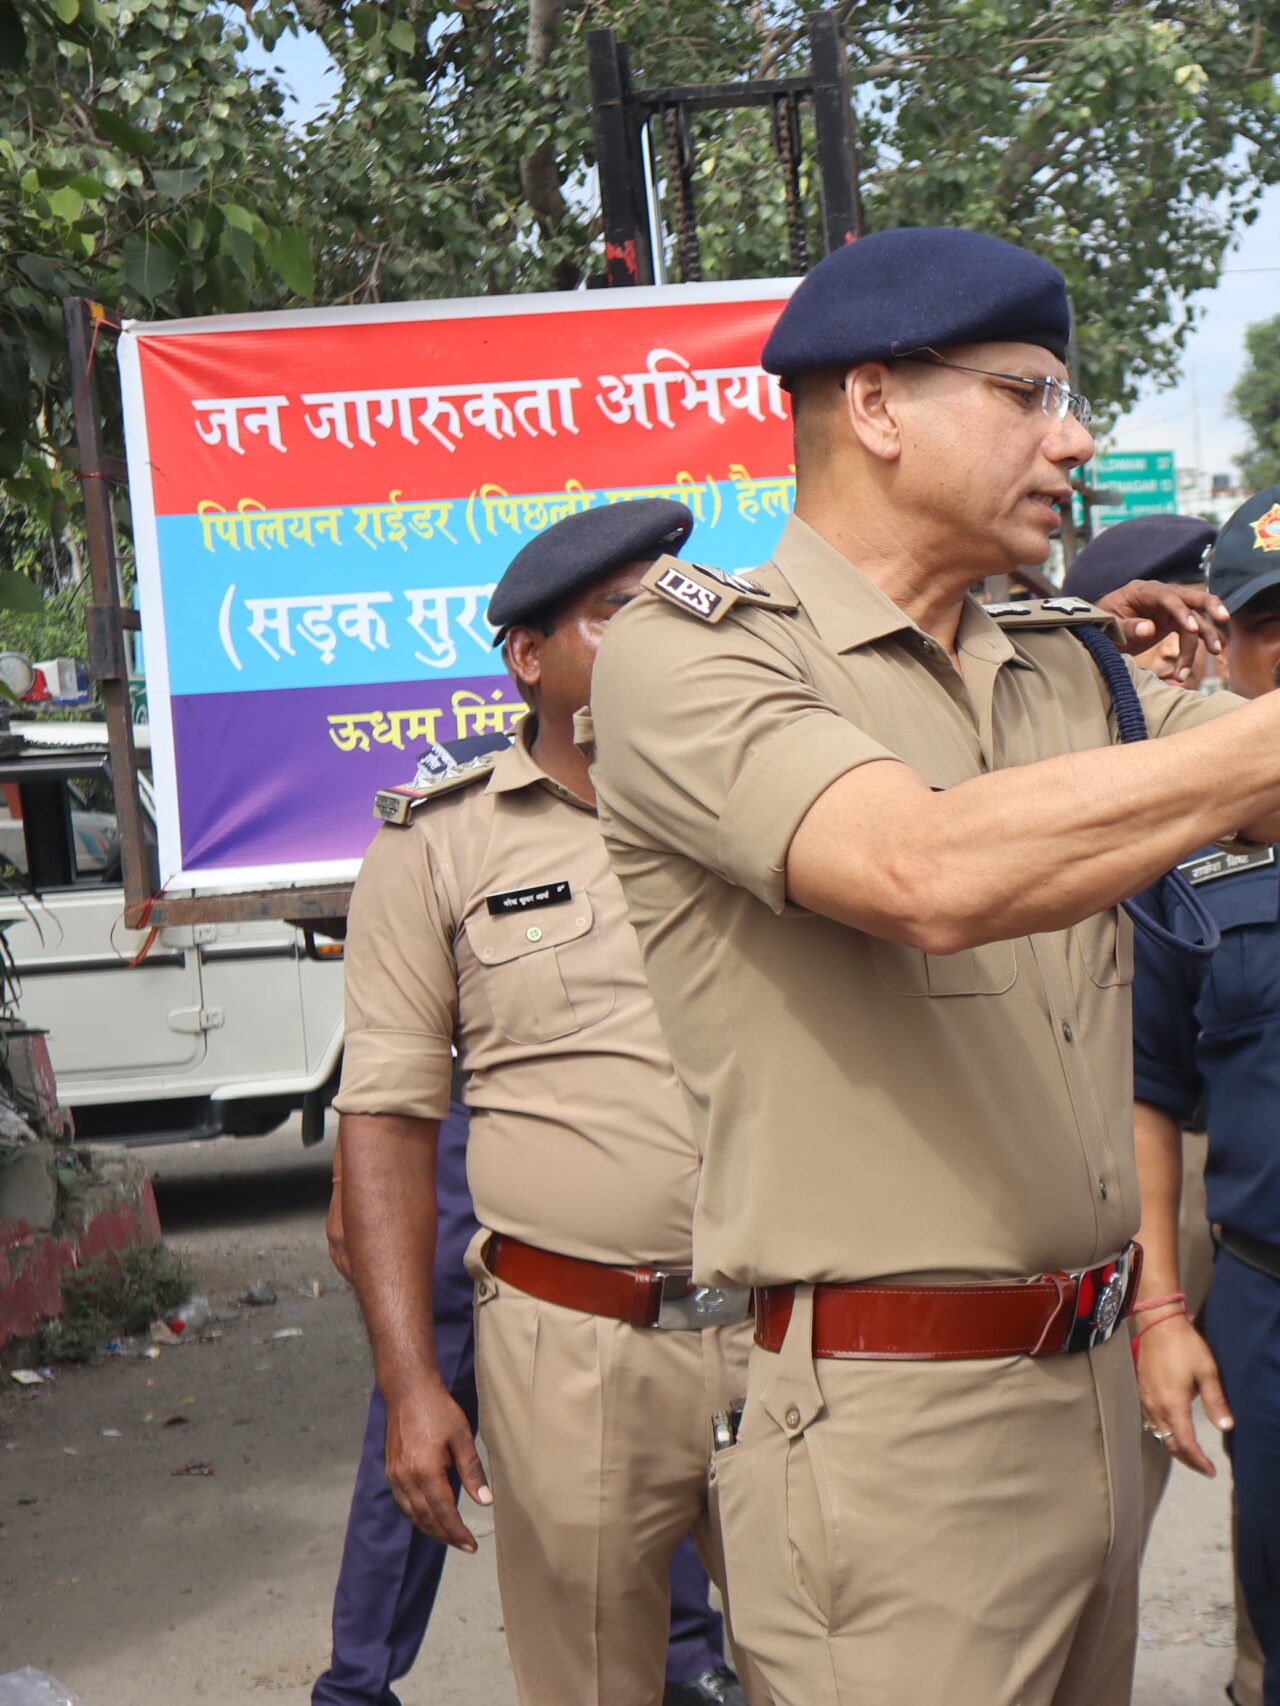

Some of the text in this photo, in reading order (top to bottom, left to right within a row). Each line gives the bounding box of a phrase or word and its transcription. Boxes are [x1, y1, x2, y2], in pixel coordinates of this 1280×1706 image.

[192, 347, 789, 456] जन जागरुकता अभिया
[197, 497, 344, 553] पिलियन
[351, 489, 459, 551] राईडर
[727, 463, 797, 523] हैल
[217, 582, 501, 671] (सड़क सुर
[656, 567, 718, 614] IPS
[326, 687, 531, 753] ऊधम सिं
